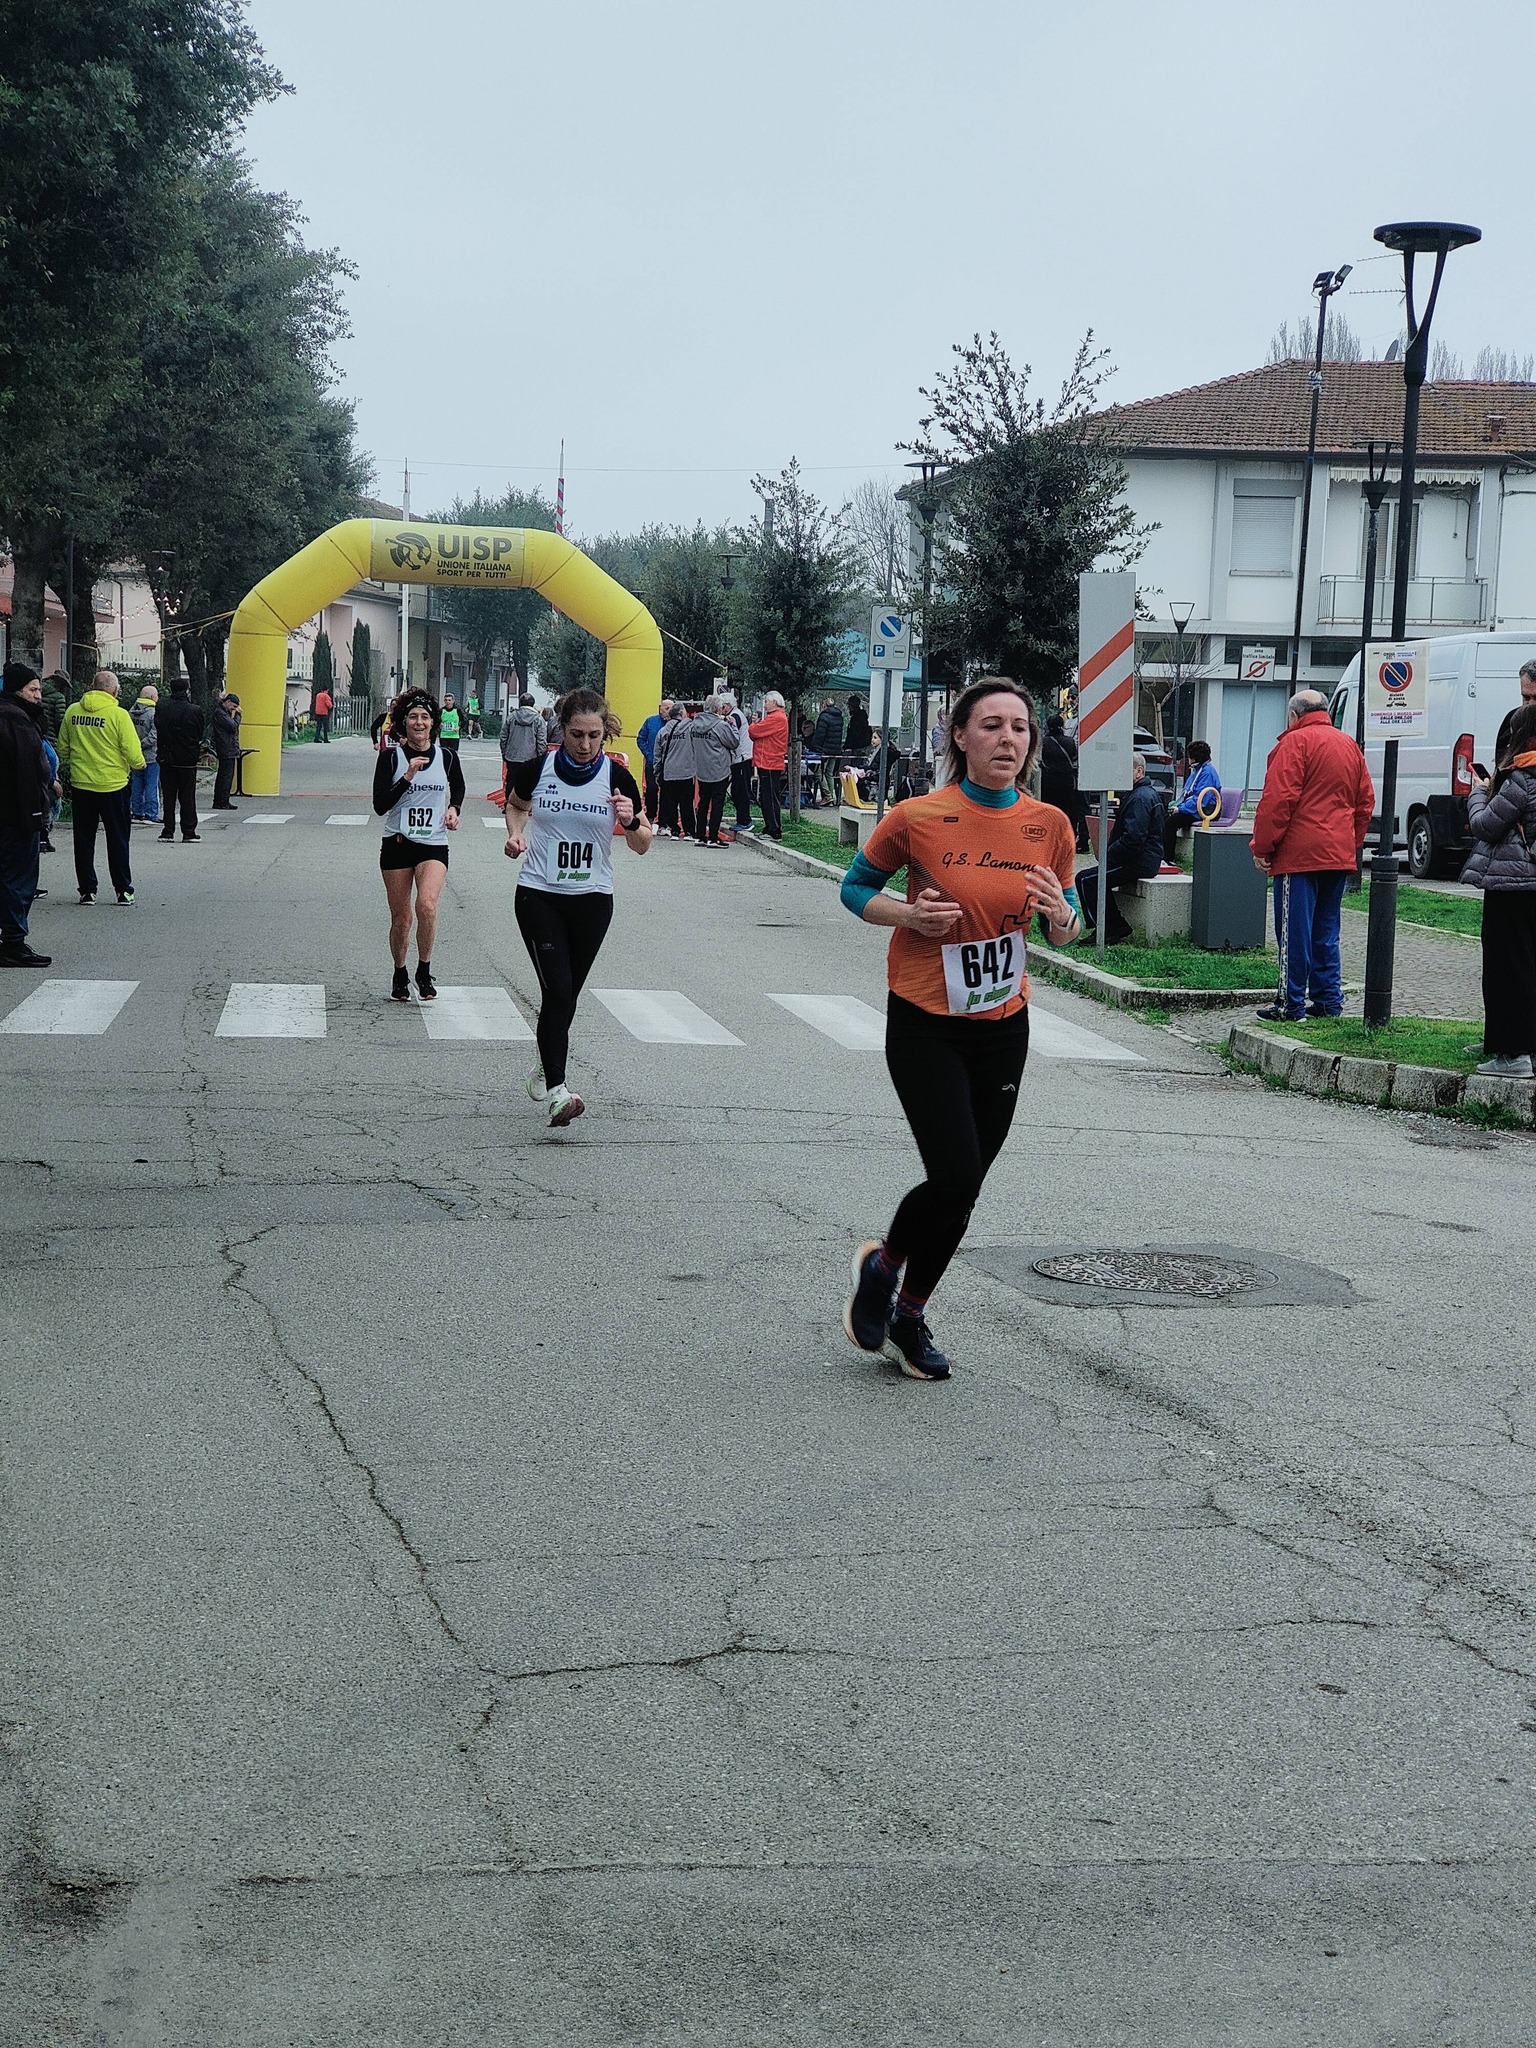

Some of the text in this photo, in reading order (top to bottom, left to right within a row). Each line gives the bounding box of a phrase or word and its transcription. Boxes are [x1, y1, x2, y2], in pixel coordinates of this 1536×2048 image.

[437, 534, 512, 561] UISP
[436, 560, 512, 572] UNIONE ITALIANA
[436, 568, 507, 579] SPORT PER TUTTI
[71, 714, 106, 729] GIUDICE
[538, 797, 608, 816] lughesina
[408, 807, 433, 828] 632
[557, 841, 594, 869] 604
[941, 852, 971, 869] G.S.
[960, 936, 1015, 989] 642
